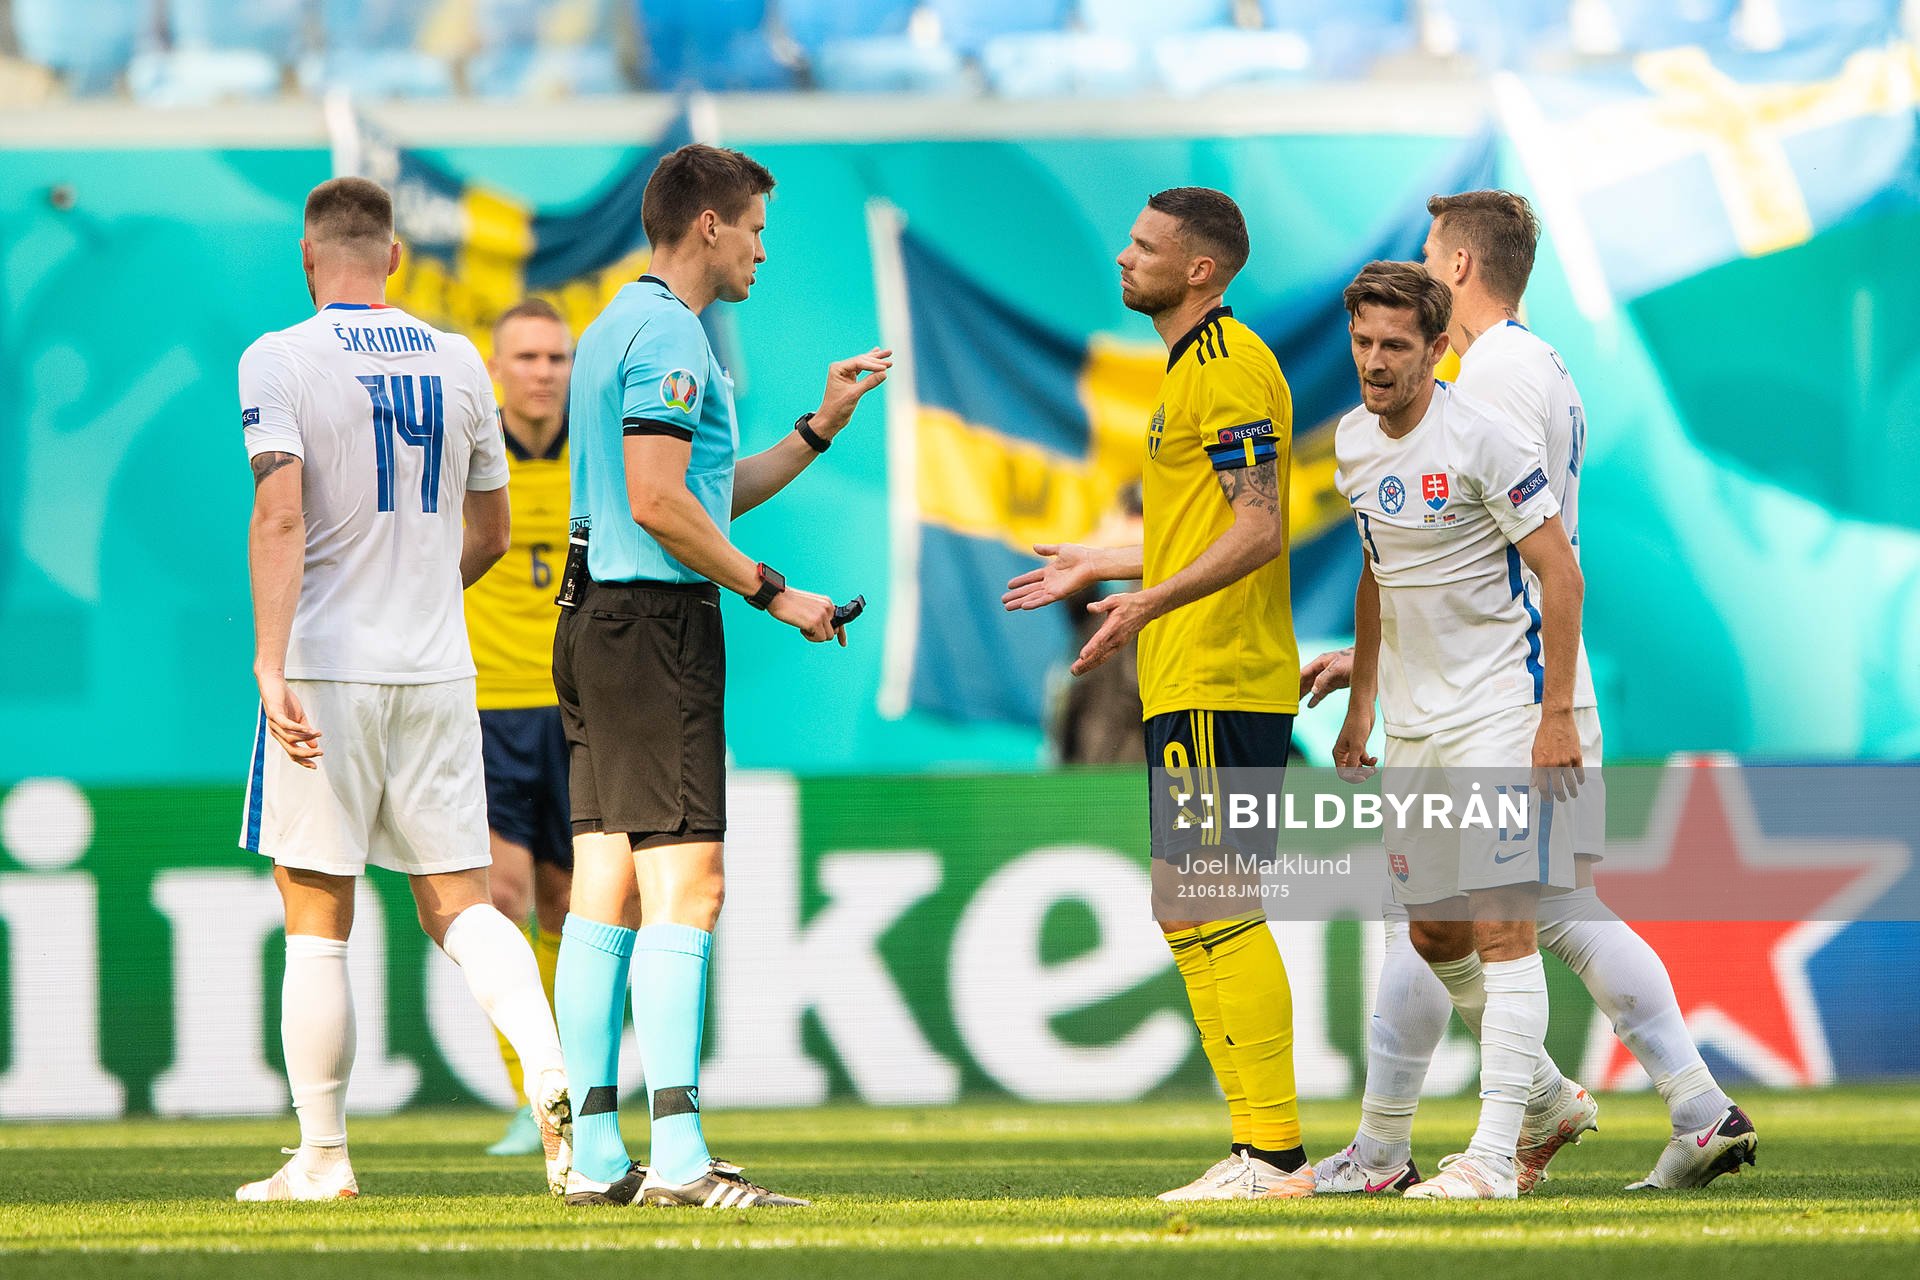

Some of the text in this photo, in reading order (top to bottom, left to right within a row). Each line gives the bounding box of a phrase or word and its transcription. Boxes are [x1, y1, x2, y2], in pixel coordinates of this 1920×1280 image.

[354, 374, 445, 514] 14
[1234, 423, 1272, 440] RESPECT
[1520, 472, 1546, 496] RESPECT
[531, 542, 552, 589] 6
[1163, 741, 1195, 803] 9
